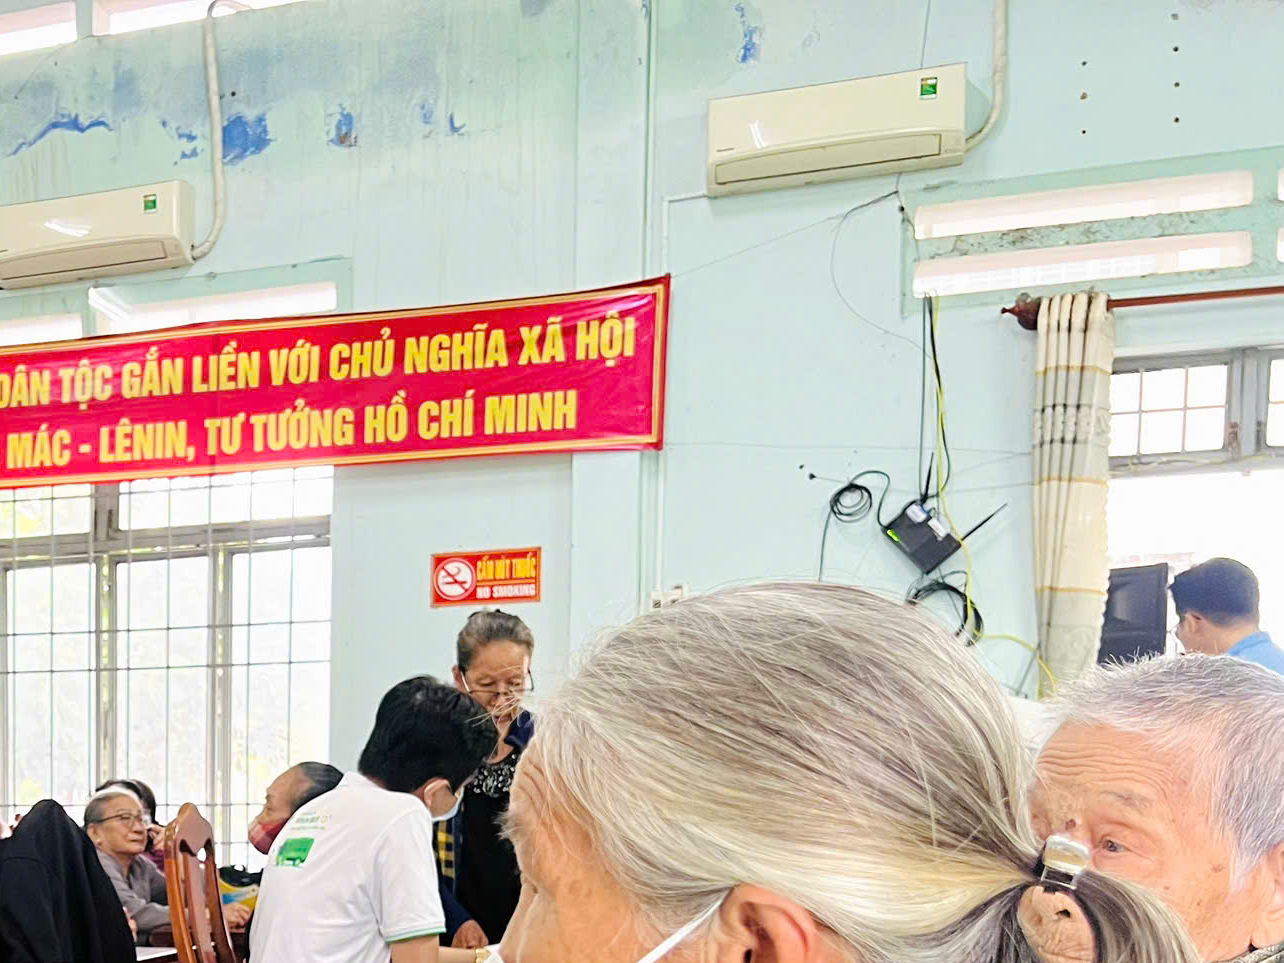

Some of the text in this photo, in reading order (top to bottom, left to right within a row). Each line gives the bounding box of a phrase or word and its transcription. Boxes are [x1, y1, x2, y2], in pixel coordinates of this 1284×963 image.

[58, 360, 113, 411] TỘC
[121, 351, 183, 398] GẮN
[192, 341, 260, 394] LIỀN
[269, 339, 320, 386] VỚI
[329, 328, 394, 378] CHỦ
[404, 323, 508, 374] NGHĨA
[518, 317, 565, 365] XÃ
[575, 310, 636, 367] HỘI
[6, 423, 70, 467] MÁC
[78, 444, 91, 454] -
[100, 419, 196, 464] LÊNIN,
[205, 411, 247, 456] TƯ
[250, 398, 353, 451] TƯỞNG
[364, 390, 409, 444] HỒ
[418, 389, 474, 439] CHÍ
[484, 390, 577, 434] MINH
